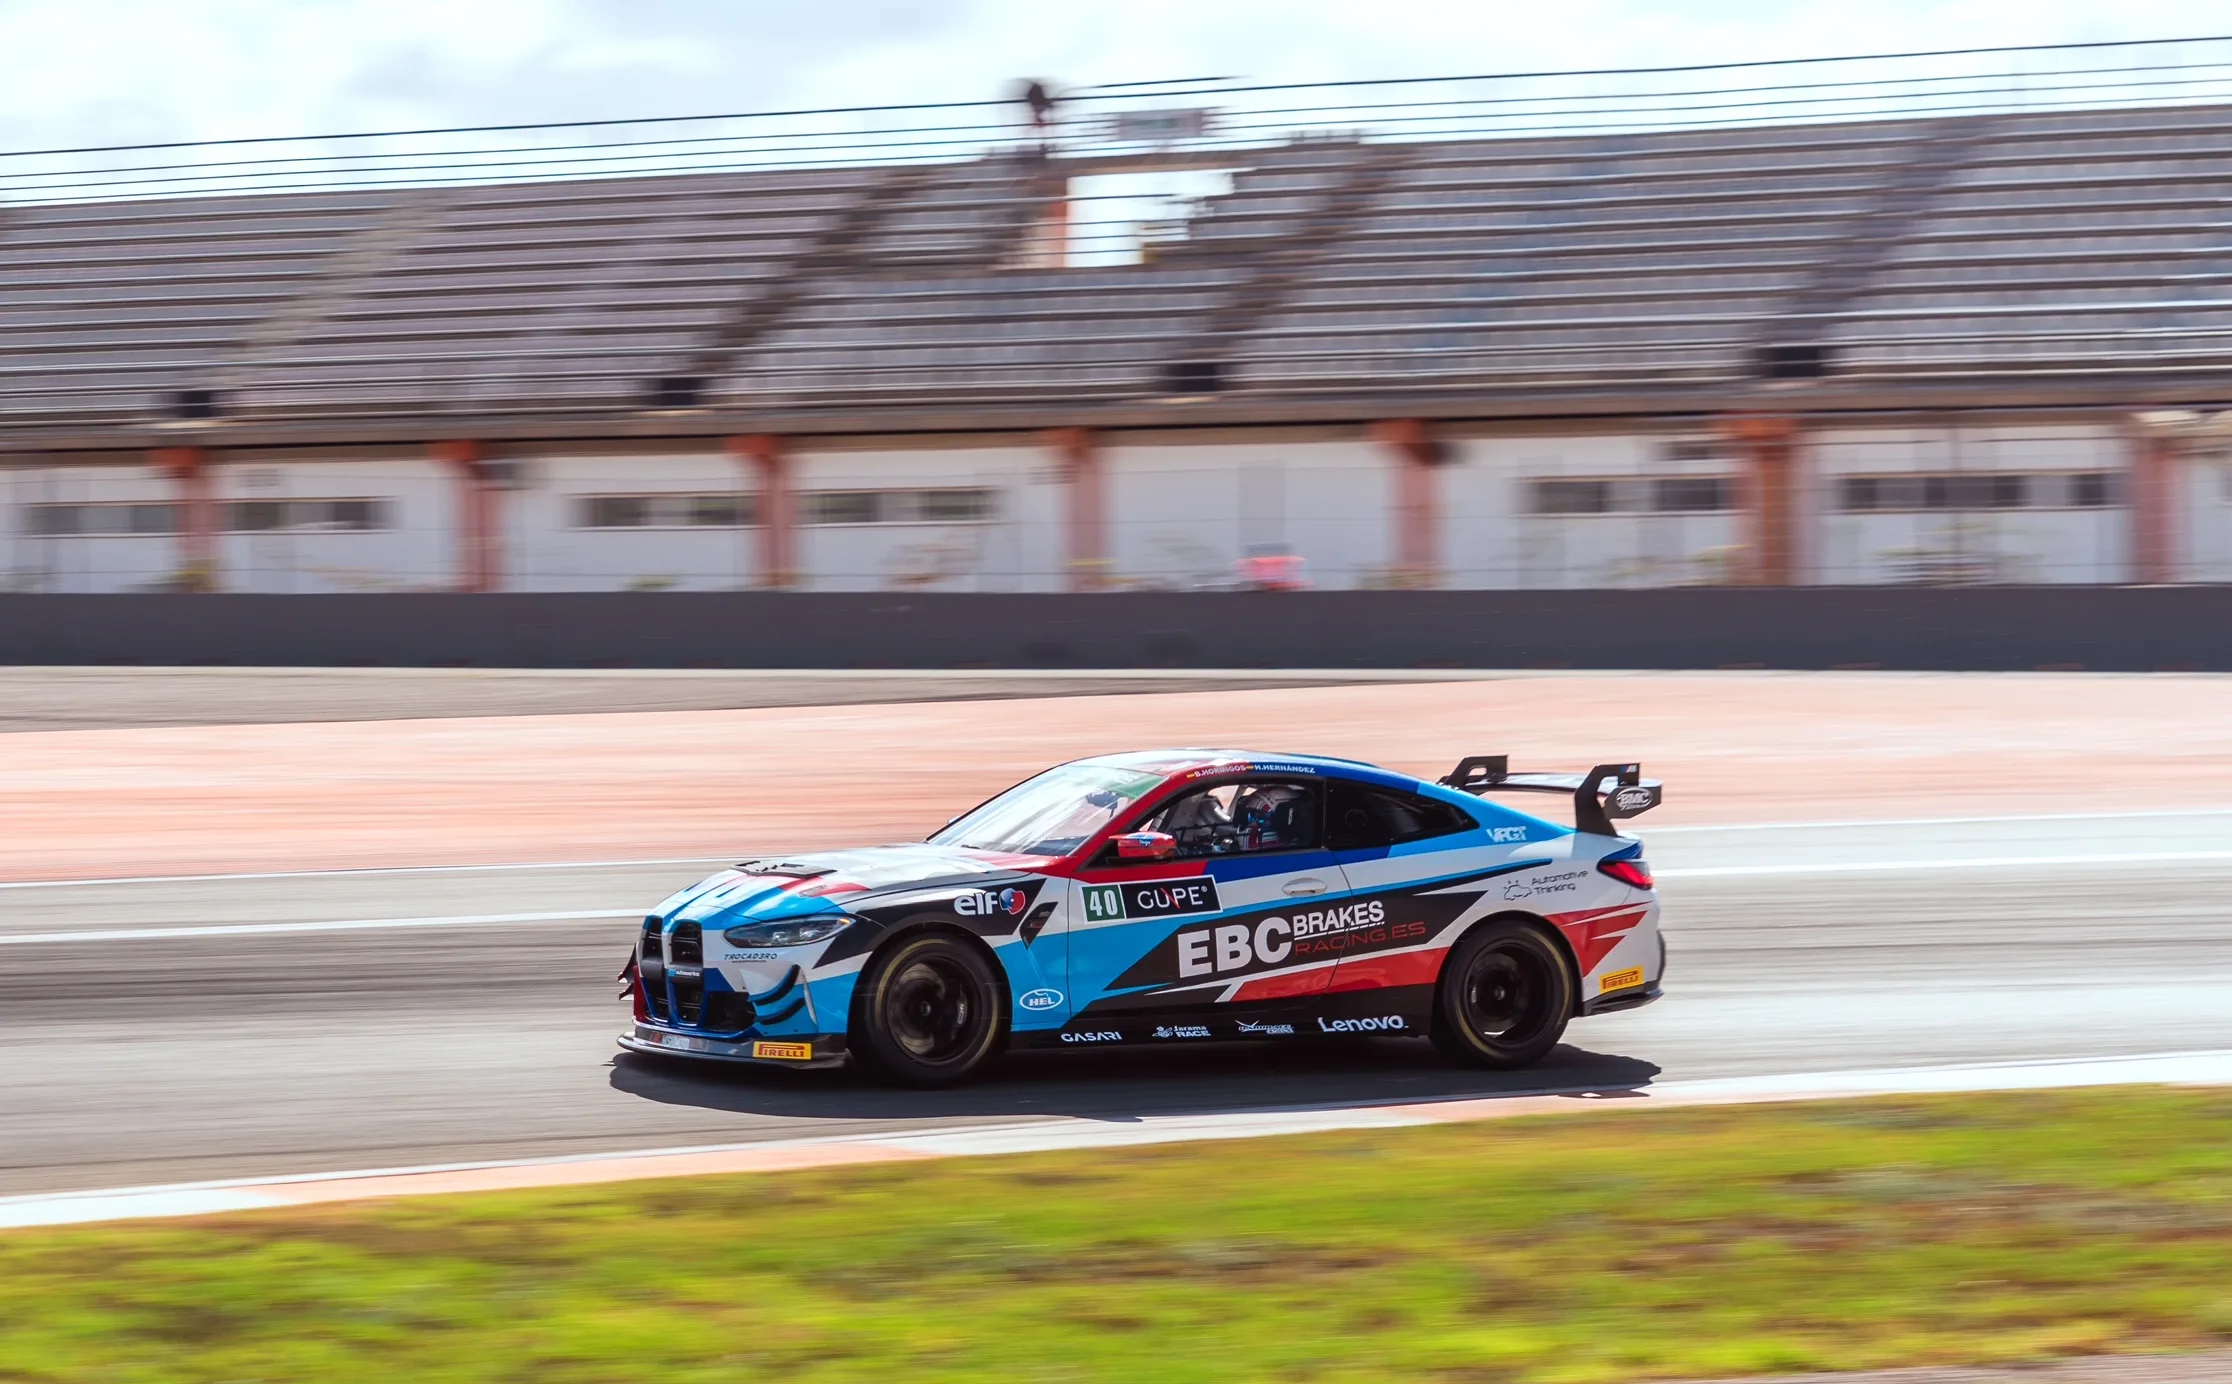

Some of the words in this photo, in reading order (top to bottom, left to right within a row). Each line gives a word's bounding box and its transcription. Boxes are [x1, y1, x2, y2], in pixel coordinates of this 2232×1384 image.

[954, 892, 998, 916] elf
[1089, 890, 1118, 916] 40
[1177, 916, 1293, 978] EBC
[1293, 901, 1385, 937] BRAKES
[1295, 921, 1427, 956] RACING.ES
[1602, 970, 1639, 989] PIRELLI
[1029, 996, 1055, 1007] HEL
[1317, 1015, 1404, 1033] Lenovo
[1060, 1031, 1123, 1042] GASARI
[758, 1043, 805, 1058] PIRELLI
